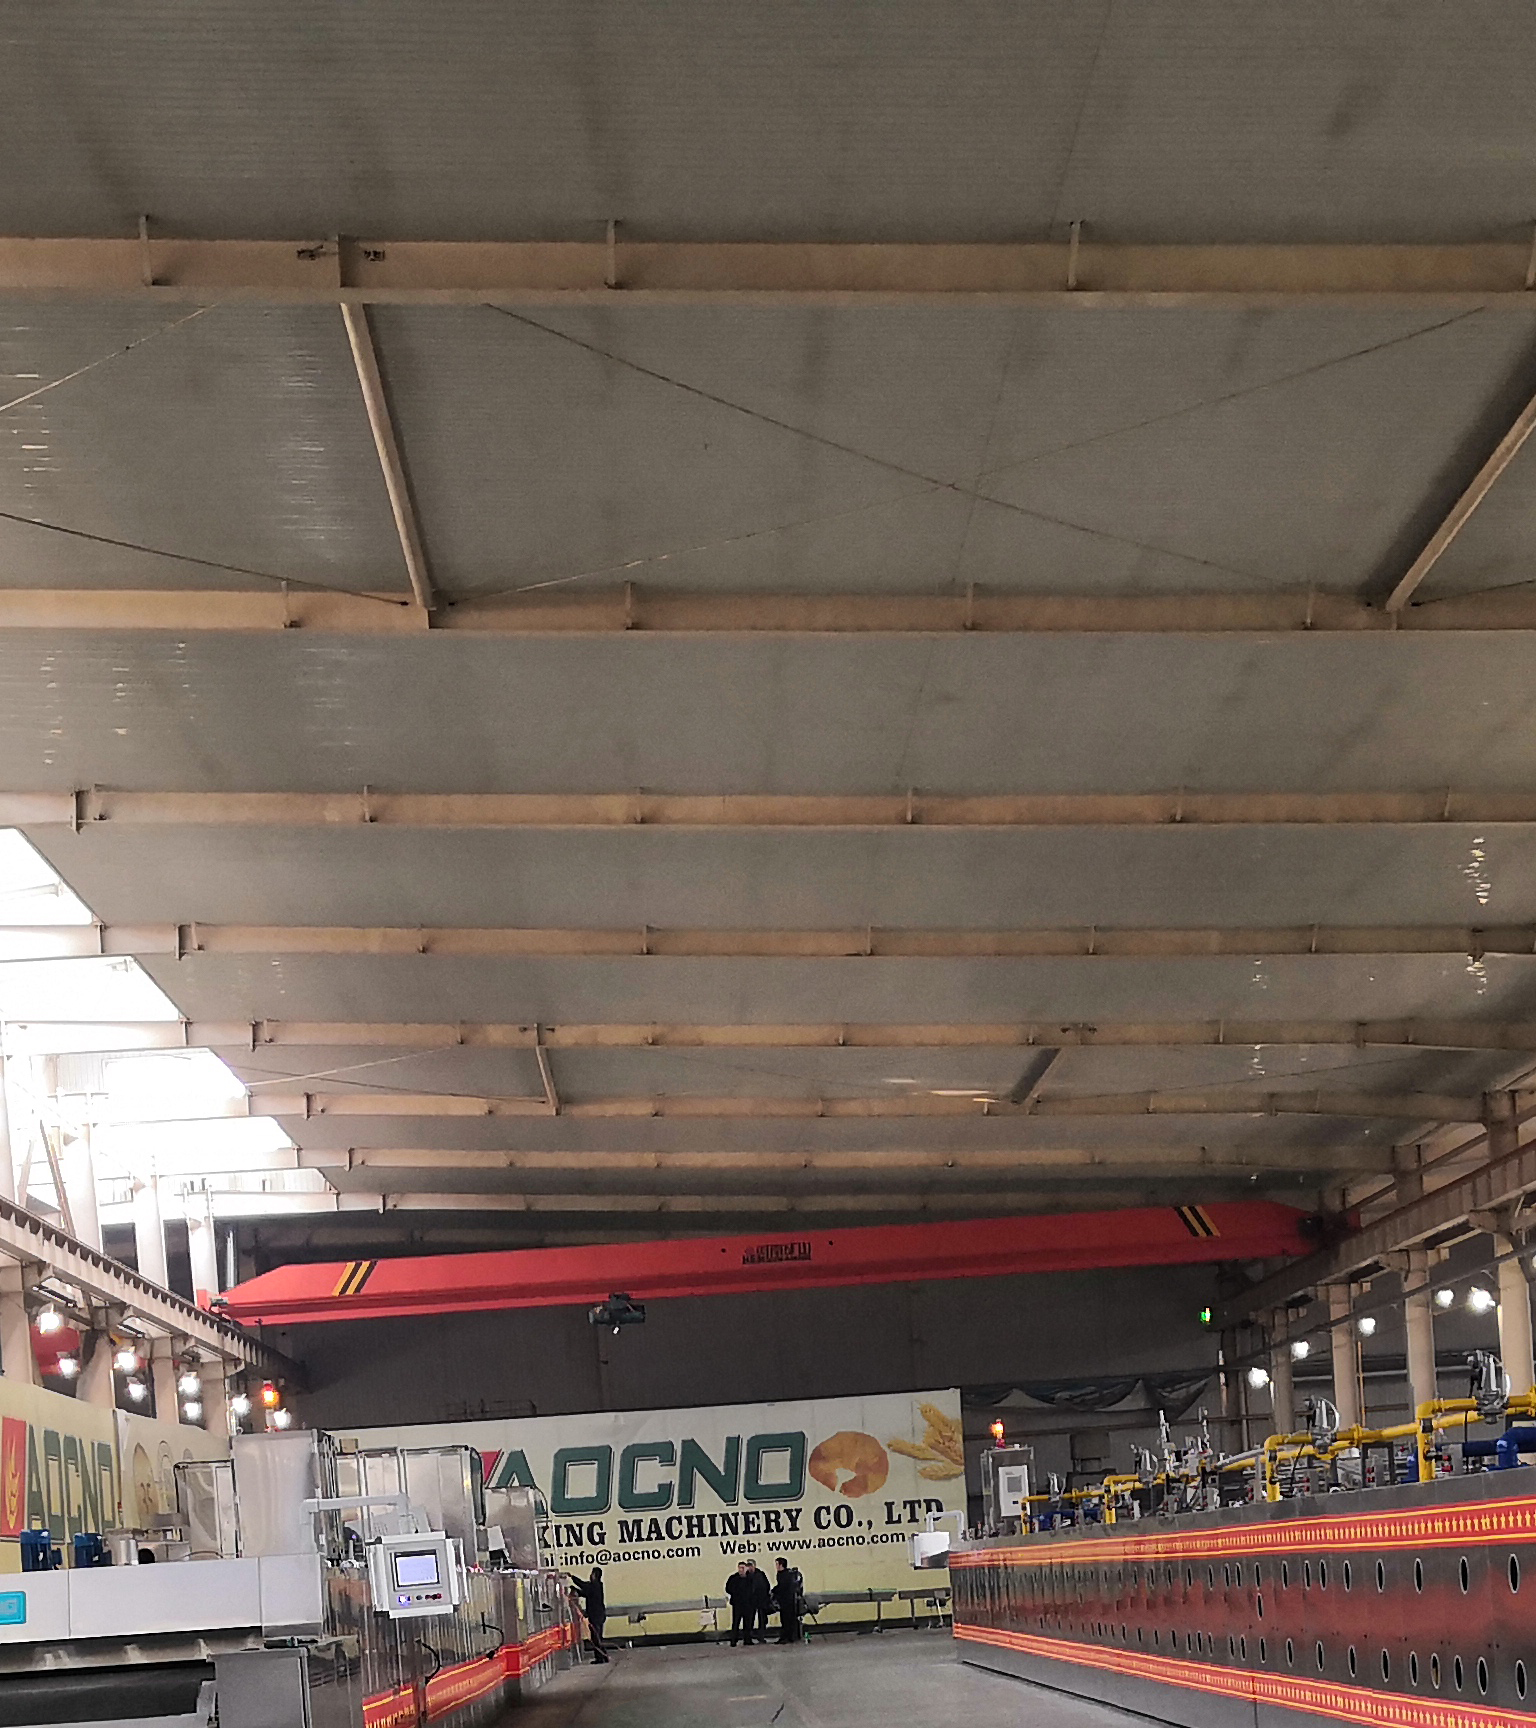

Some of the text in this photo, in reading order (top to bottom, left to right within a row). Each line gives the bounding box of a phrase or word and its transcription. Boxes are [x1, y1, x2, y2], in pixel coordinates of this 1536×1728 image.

[27, 1423, 114, 1543] AOCNO
[494, 1430, 809, 1518] AOCNO
[617, 1507, 803, 1544] MACHINERY
[814, 1504, 874, 1531] CO.,
[883, 1498, 945, 1525] LTD
[720, 1540, 762, 1555] Web:
[767, 1531, 906, 1552] www.aocno.com
